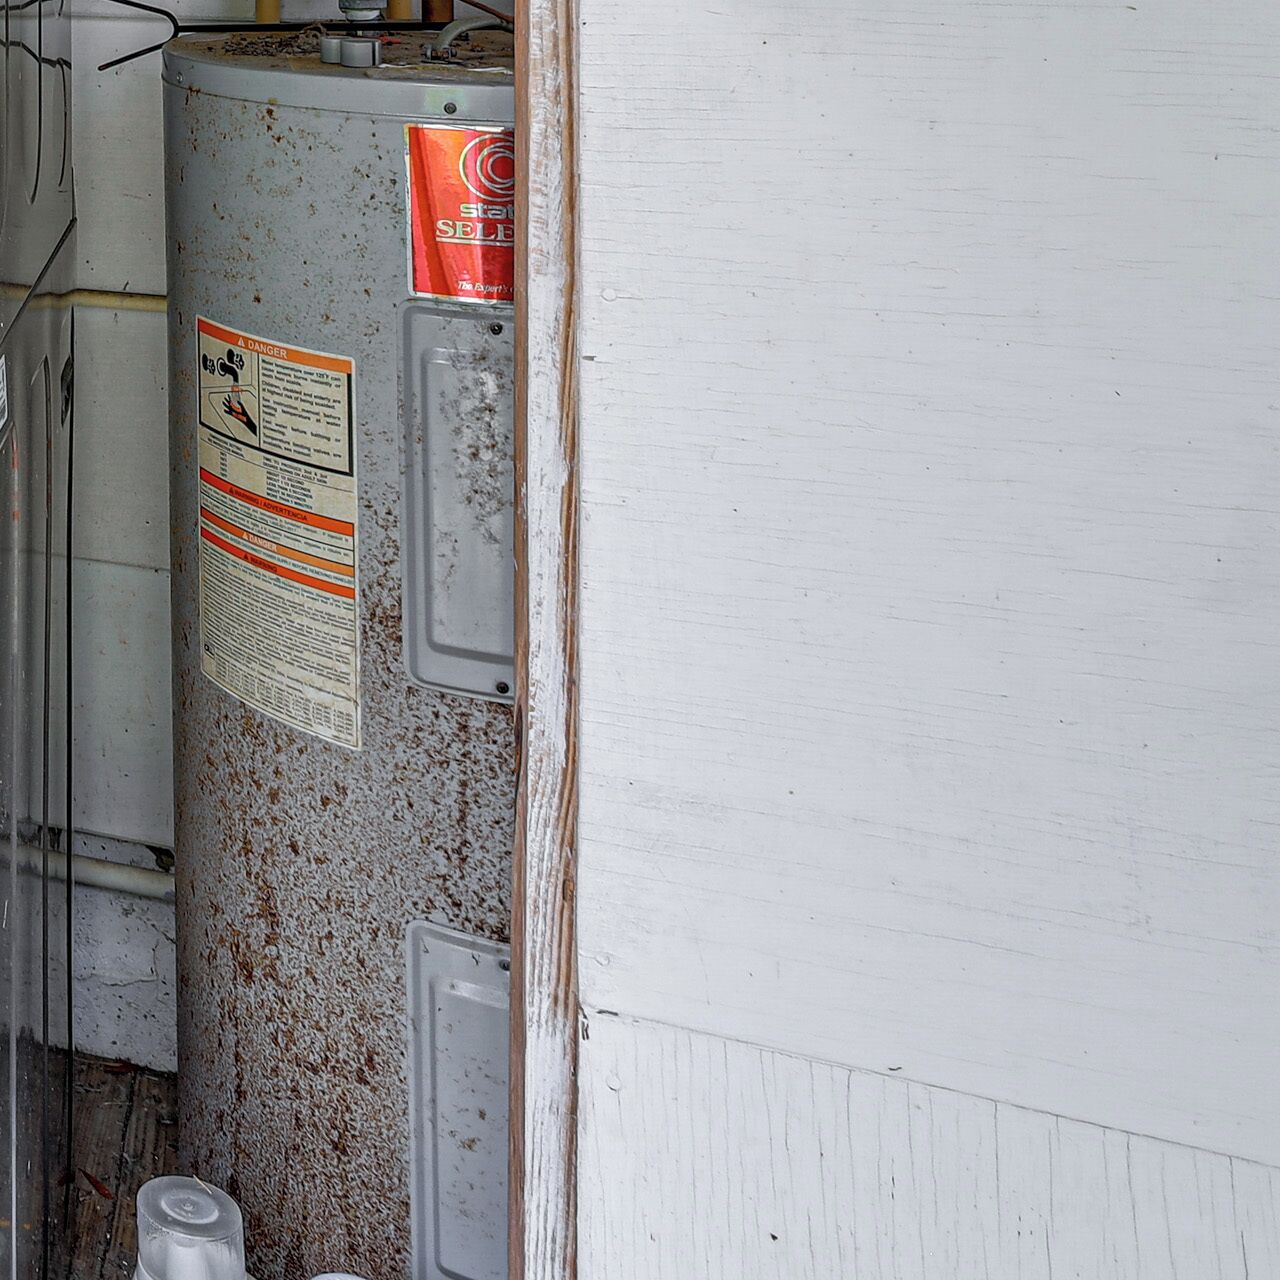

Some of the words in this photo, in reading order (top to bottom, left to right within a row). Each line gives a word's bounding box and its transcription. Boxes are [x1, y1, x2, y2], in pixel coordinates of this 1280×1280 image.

[436, 219, 513, 241] SELE
[458, 281, 473, 290] The
[248, 339, 288, 359] DANGER
